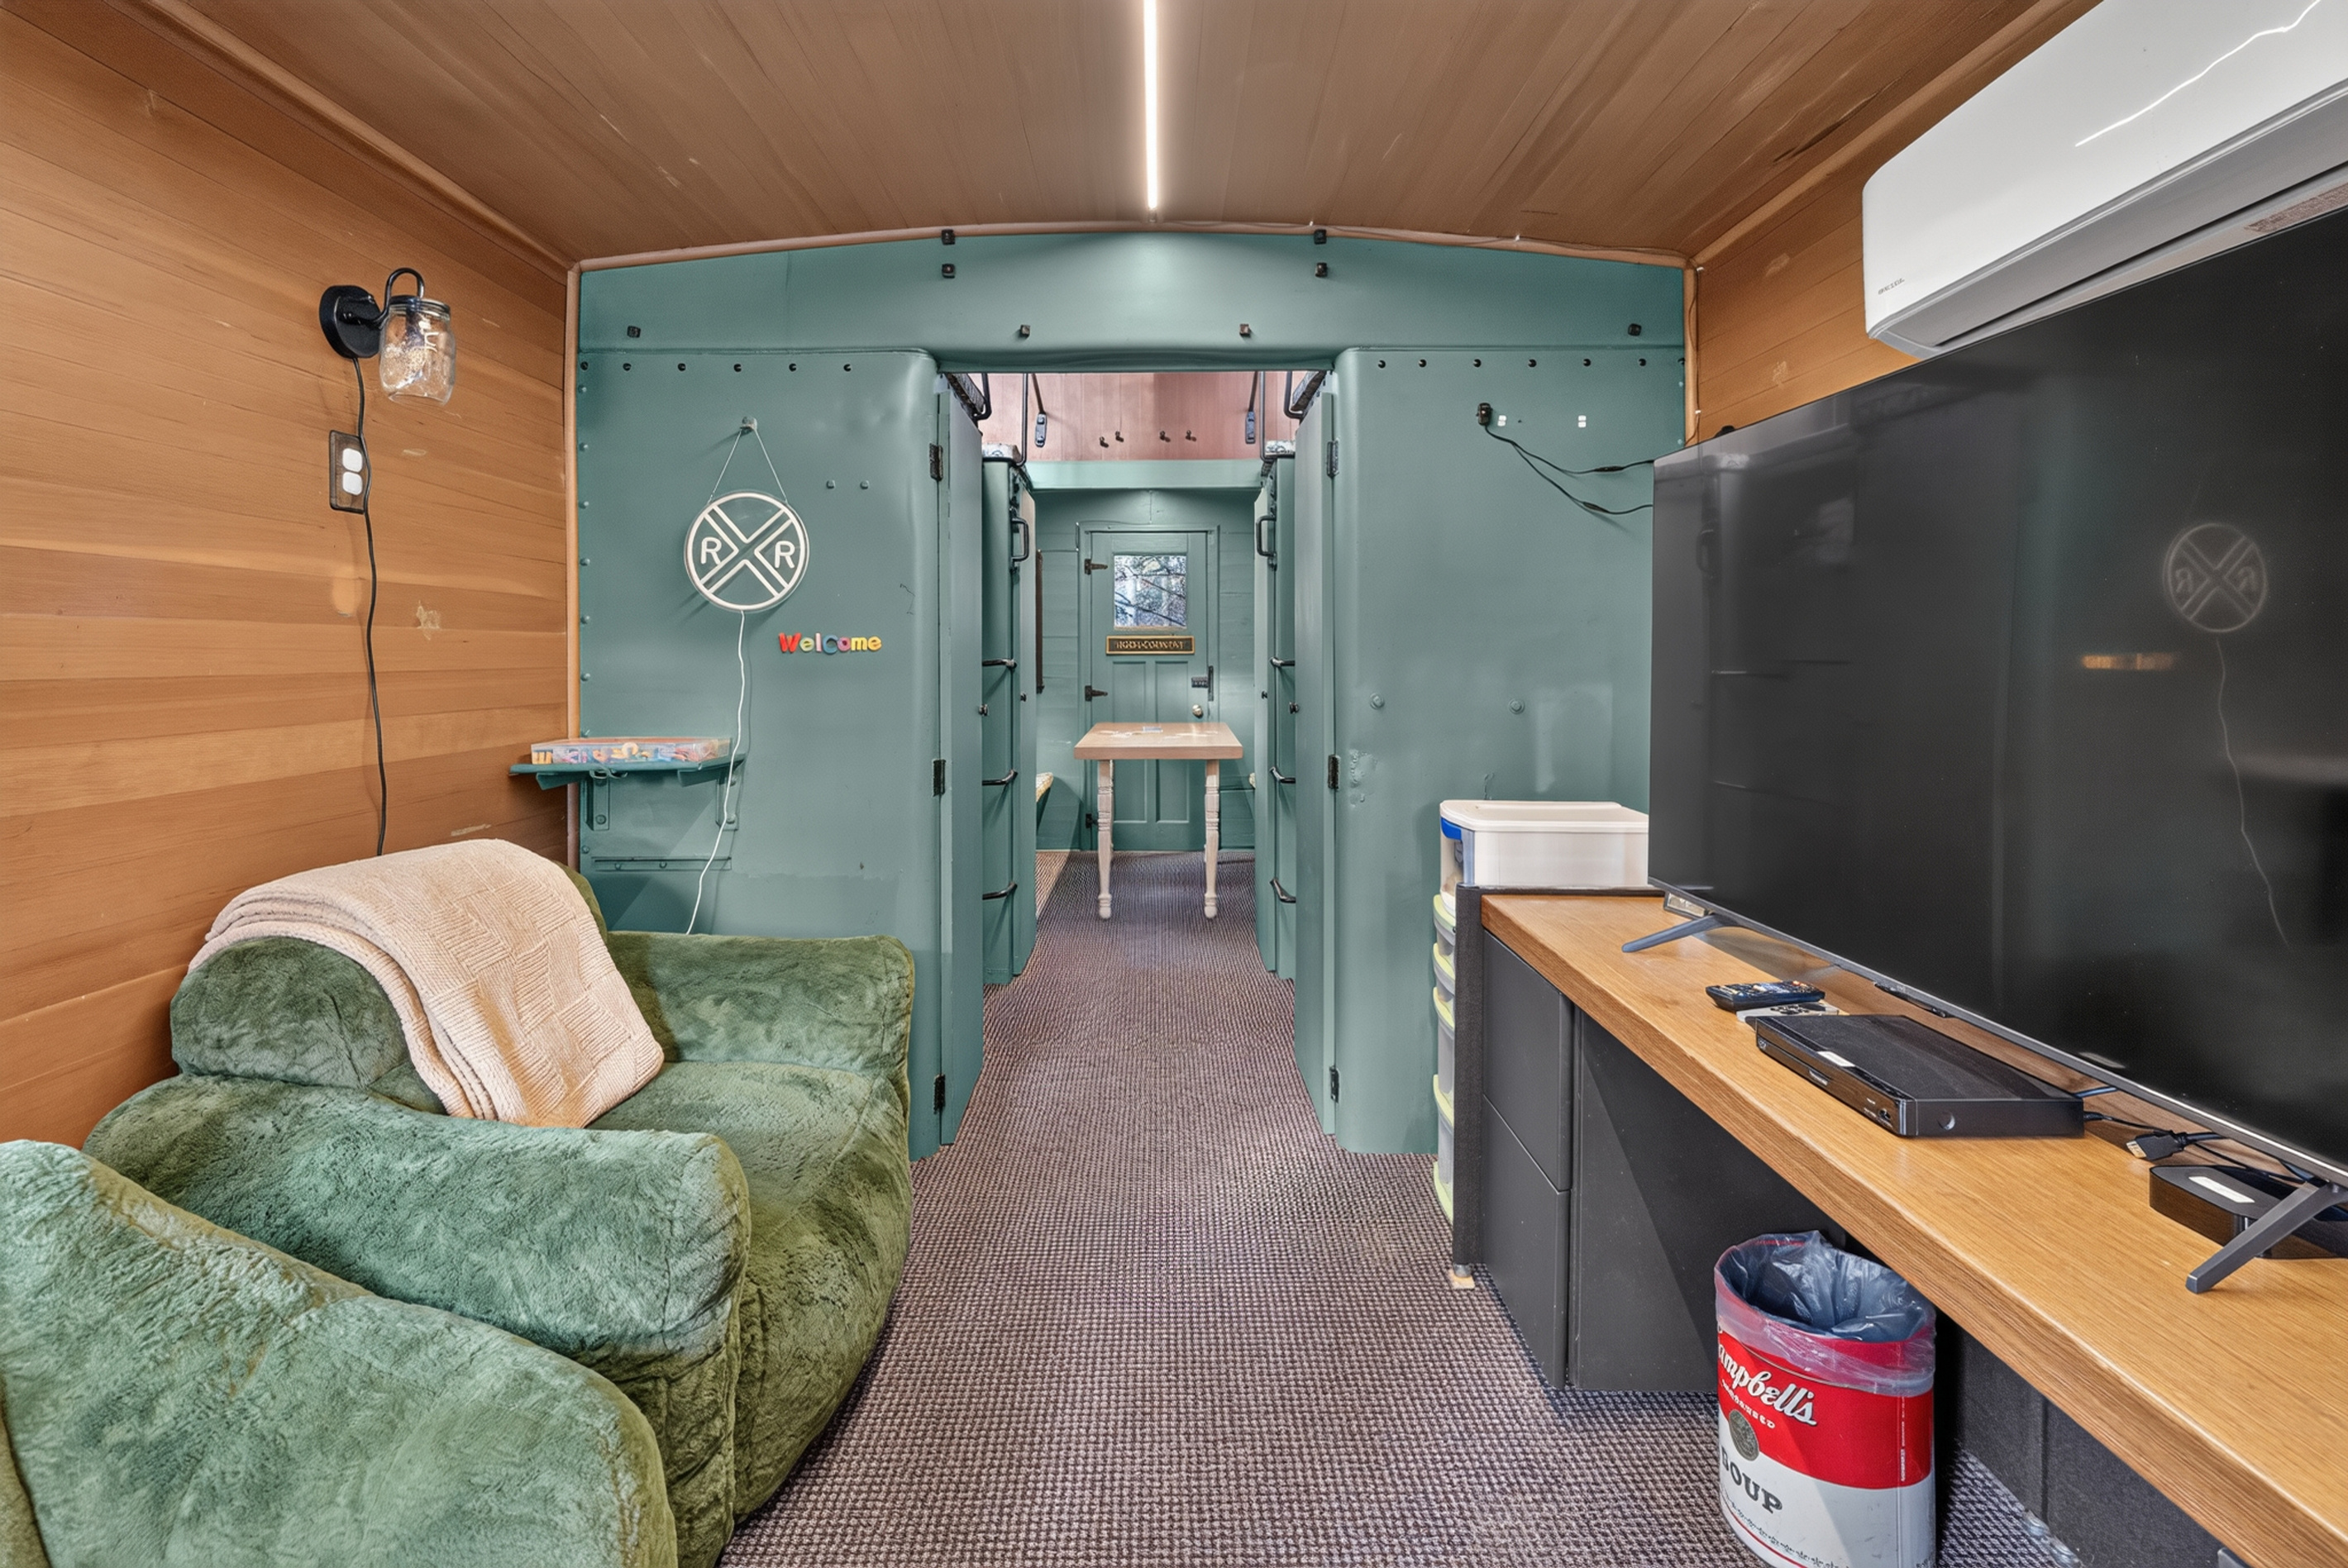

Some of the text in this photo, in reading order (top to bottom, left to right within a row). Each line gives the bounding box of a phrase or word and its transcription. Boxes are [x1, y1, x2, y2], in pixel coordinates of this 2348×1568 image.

[700, 536, 722, 565] R
[774, 540, 795, 569] R
[1719, 1342, 1817, 1426] ampbell's
